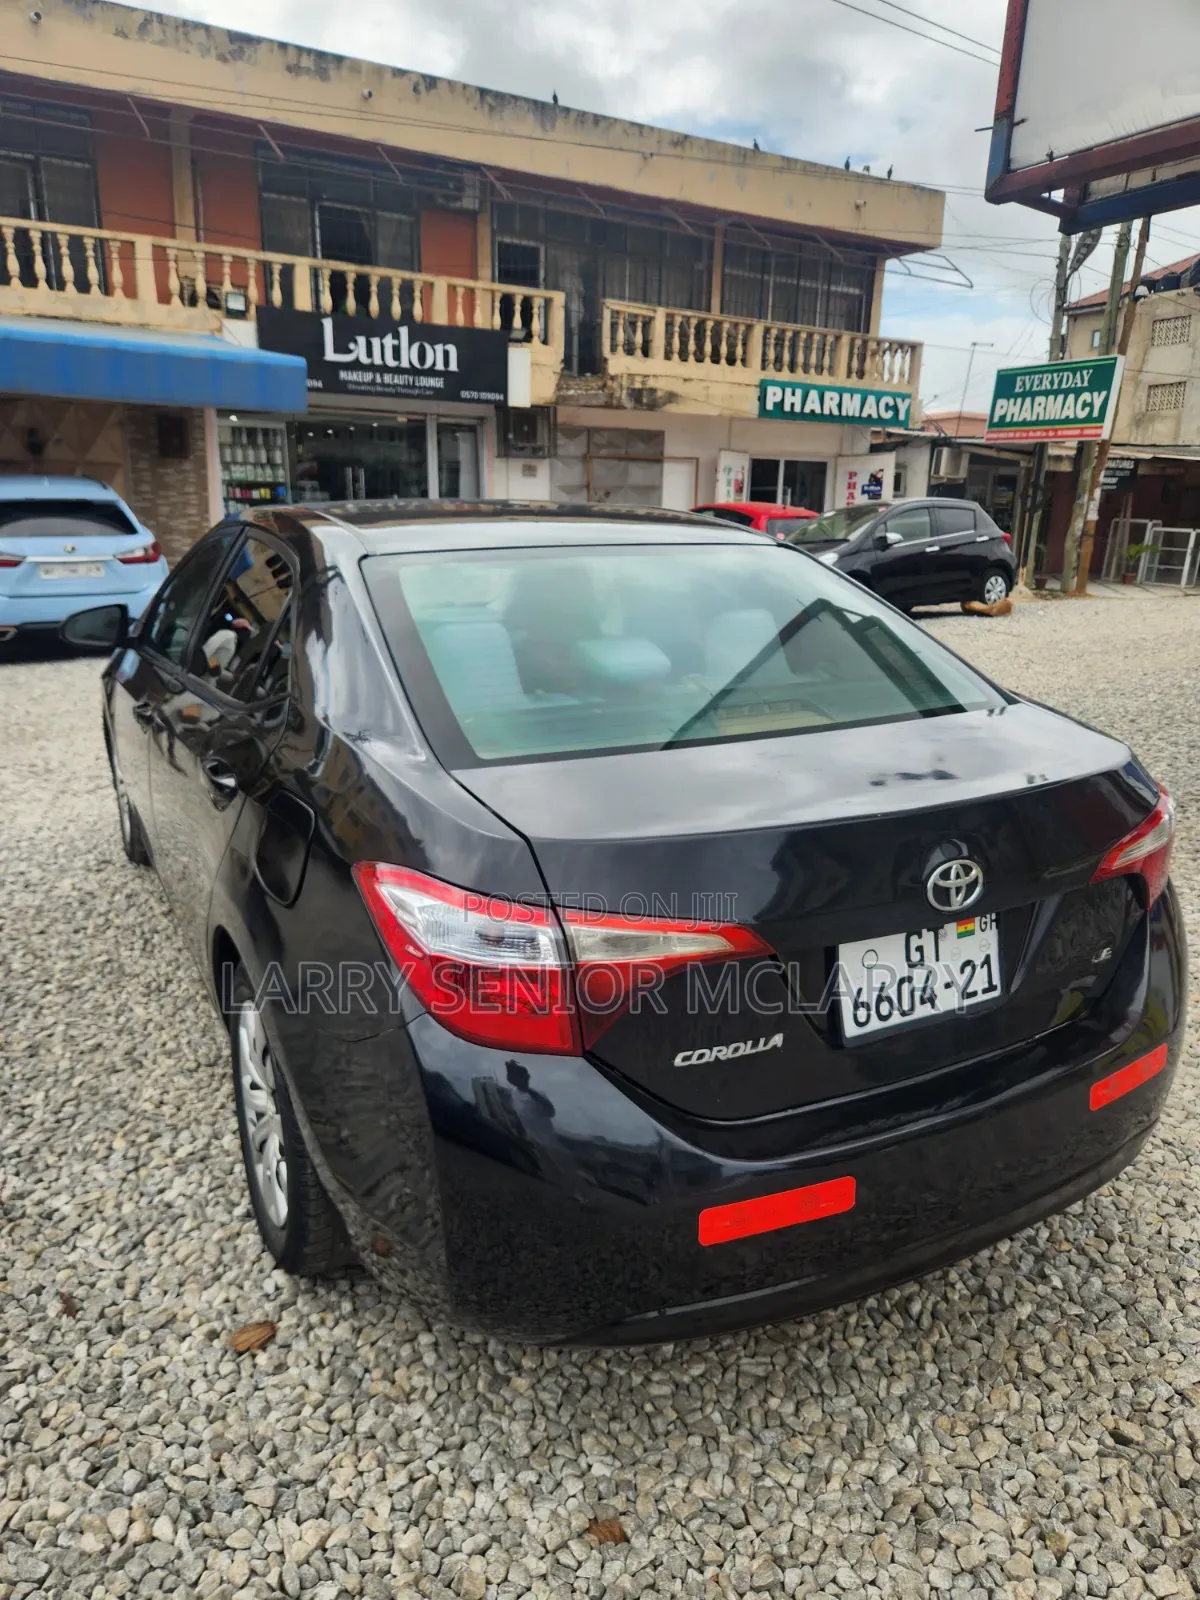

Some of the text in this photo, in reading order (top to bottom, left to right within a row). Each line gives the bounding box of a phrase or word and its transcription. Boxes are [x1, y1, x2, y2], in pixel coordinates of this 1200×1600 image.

[321, 317, 459, 372] Lutlon
[339, 369, 445, 389] MAKEUP & BEAUTY LOUNGE
[1014, 369, 1094, 393] EVERYDAY
[765, 385, 911, 421] PHARMACY
[993, 390, 1107, 424] PHARMACY
[979, 914, 998, 932] GH
[905, 927, 944, 969] GT
[852, 953, 998, 1028] 6604-21
[673, 1033, 784, 1067] COROLLA
